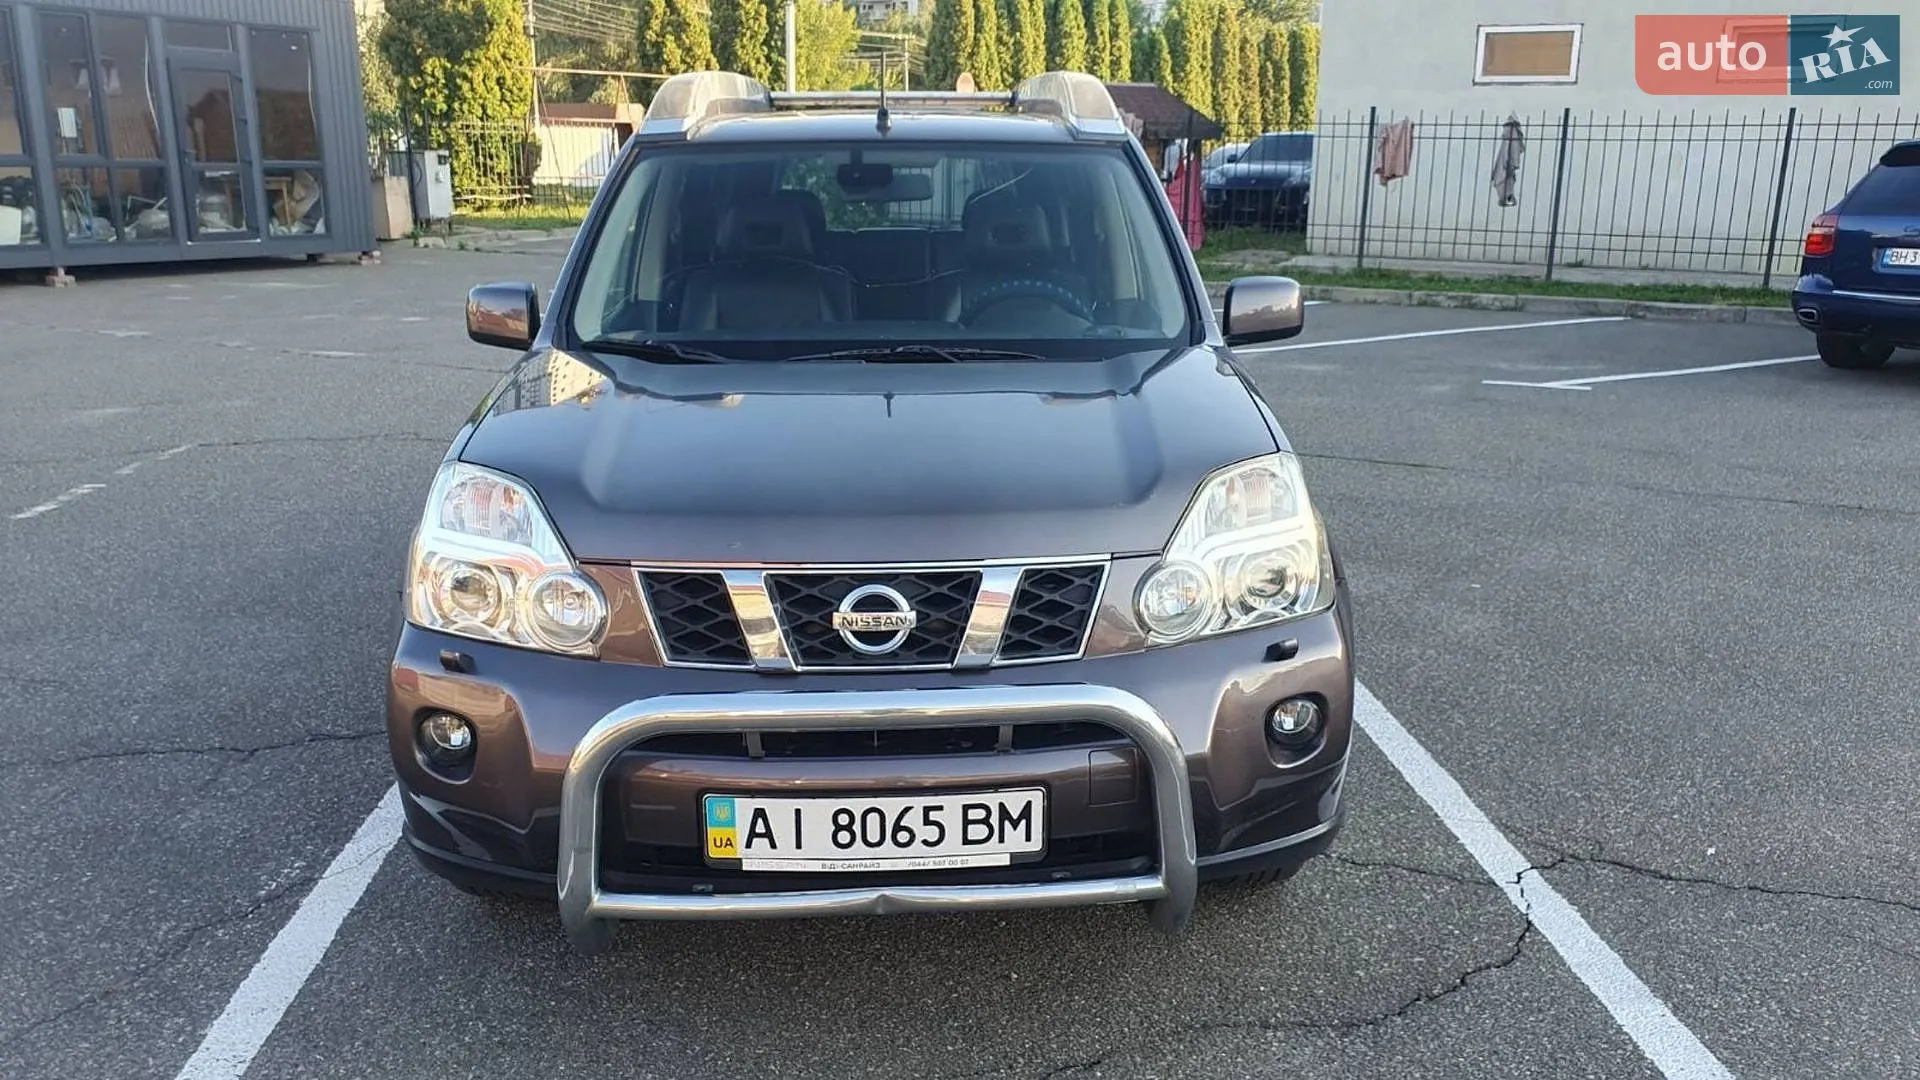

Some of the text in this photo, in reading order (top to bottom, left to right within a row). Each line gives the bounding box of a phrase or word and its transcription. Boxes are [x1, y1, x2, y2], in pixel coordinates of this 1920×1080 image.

[841, 615, 908, 628] NISSAN
[745, 800, 1032, 850] AI 8065 BM
[713, 837, 734, 849] UA
